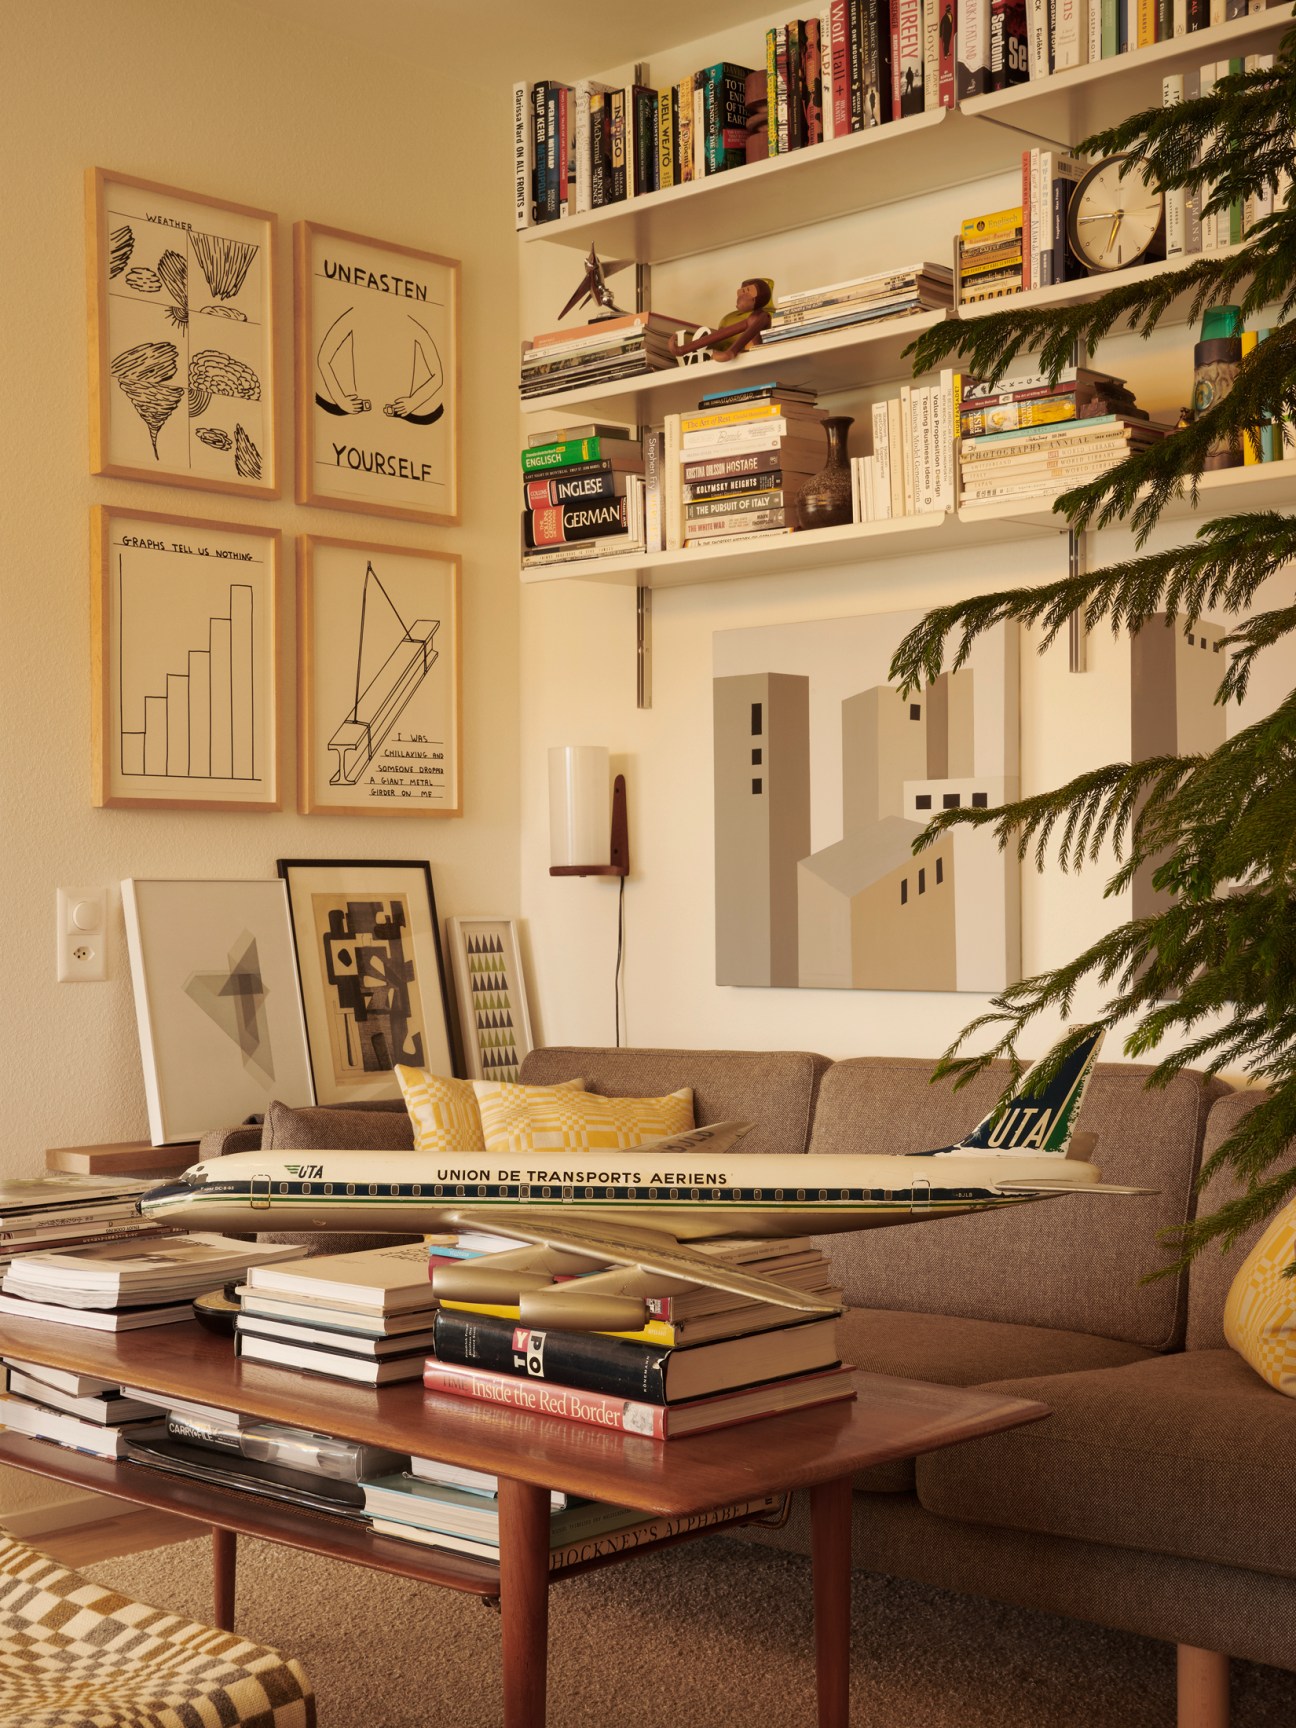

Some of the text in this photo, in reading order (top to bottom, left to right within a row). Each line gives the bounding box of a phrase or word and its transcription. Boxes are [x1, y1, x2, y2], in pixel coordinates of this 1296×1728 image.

[868, 20, 878, 49] Justice
[901, 0, 918, 59] FIREFLY
[831, 3, 845, 81] Wolf Hall
[925, 22, 938, 63] Boyd
[966, 24, 977, 60] FATLAND
[991, 12, 1005, 73] Serotonin
[822, 44, 830, 77] ALPS
[869, 50, 879, 78] Sleeps
[708, 79, 715, 90] TO
[725, 79, 737, 90] TO
[726, 101, 736, 112] OF
[661, 94, 670, 167] KJELL WESTÖ
[709, 125, 715, 134] OF
[727, 114, 746, 126] EART
[593, 118, 602, 165] McDermid
[614, 106, 622, 158] INTRIGO
[516, 89, 525, 208] Clarissa Ward ON ALL FRONTS
[536, 87, 546, 203] PHILIP KERR METROPOLIS
[146, 212, 193, 231] WEATHER
[988, 214, 1018, 229] Englisch
[1192, 197, 1200, 242] UMANS
[1031, 220, 1039, 243] ALAIN
[324, 259, 427, 301] UNFASTEN
[687, 414, 731, 430] The Art of Rest
[974, 412, 982, 433] FISK
[933, 420, 941, 467] Proposition
[969, 442, 1042, 461] PHOTOGRAPHY
[1048, 437, 1090, 449] ANNUAL
[332, 442, 432, 481] YOURSELF
[525, 453, 562, 468] ENGLISCH
[648, 438, 657, 474] Stephen
[970, 451, 1114, 480] ITALY WORLD LIBRARY
[971, 442, 1115, 471] SWITZERLAND WORLD LIBRARY
[686, 457, 758, 479] KRISTINA OHLSSON HOSTAGE
[974, 465, 1088, 488] JAPAN WORLD
[530, 489, 548, 497] COLLINS
[558, 477, 603, 499] INGLESE
[649, 476, 657, 490] Fry
[696, 478, 757, 494] KOLYMSKY HEIGHTS
[914, 461, 922, 503] Generation
[564, 504, 620, 528] GERMAN
[696, 496, 770, 515] THE PURSUIT OF ITALY
[688, 525, 697, 533] THE
[697, 522, 713, 532] WHITE
[713, 520, 726, 530] WAR
[122, 535, 253, 561] GRAPHS TELL US NOTHING
[398, 732, 428, 743] I WAS
[384, 748, 444, 760] CHILLAXING AND
[378, 764, 414, 773] SOMEONE
[370, 776, 433, 787] A GIANT METAL
[371, 788, 396, 797] GIRDER
[421, 790, 432, 798] ME
[988, 1108, 1052, 1148] UTA
[299, 1164, 324, 1179] UTA
[437, 1168, 728, 1185] UNION DE TRANSPORTS AERIENS
[441, 1375, 621, 1427] TIME Inside the Red Border
[168, 1422, 195, 1440] CARRY
[551, 1527, 658, 1570] HOCKNEY'S
